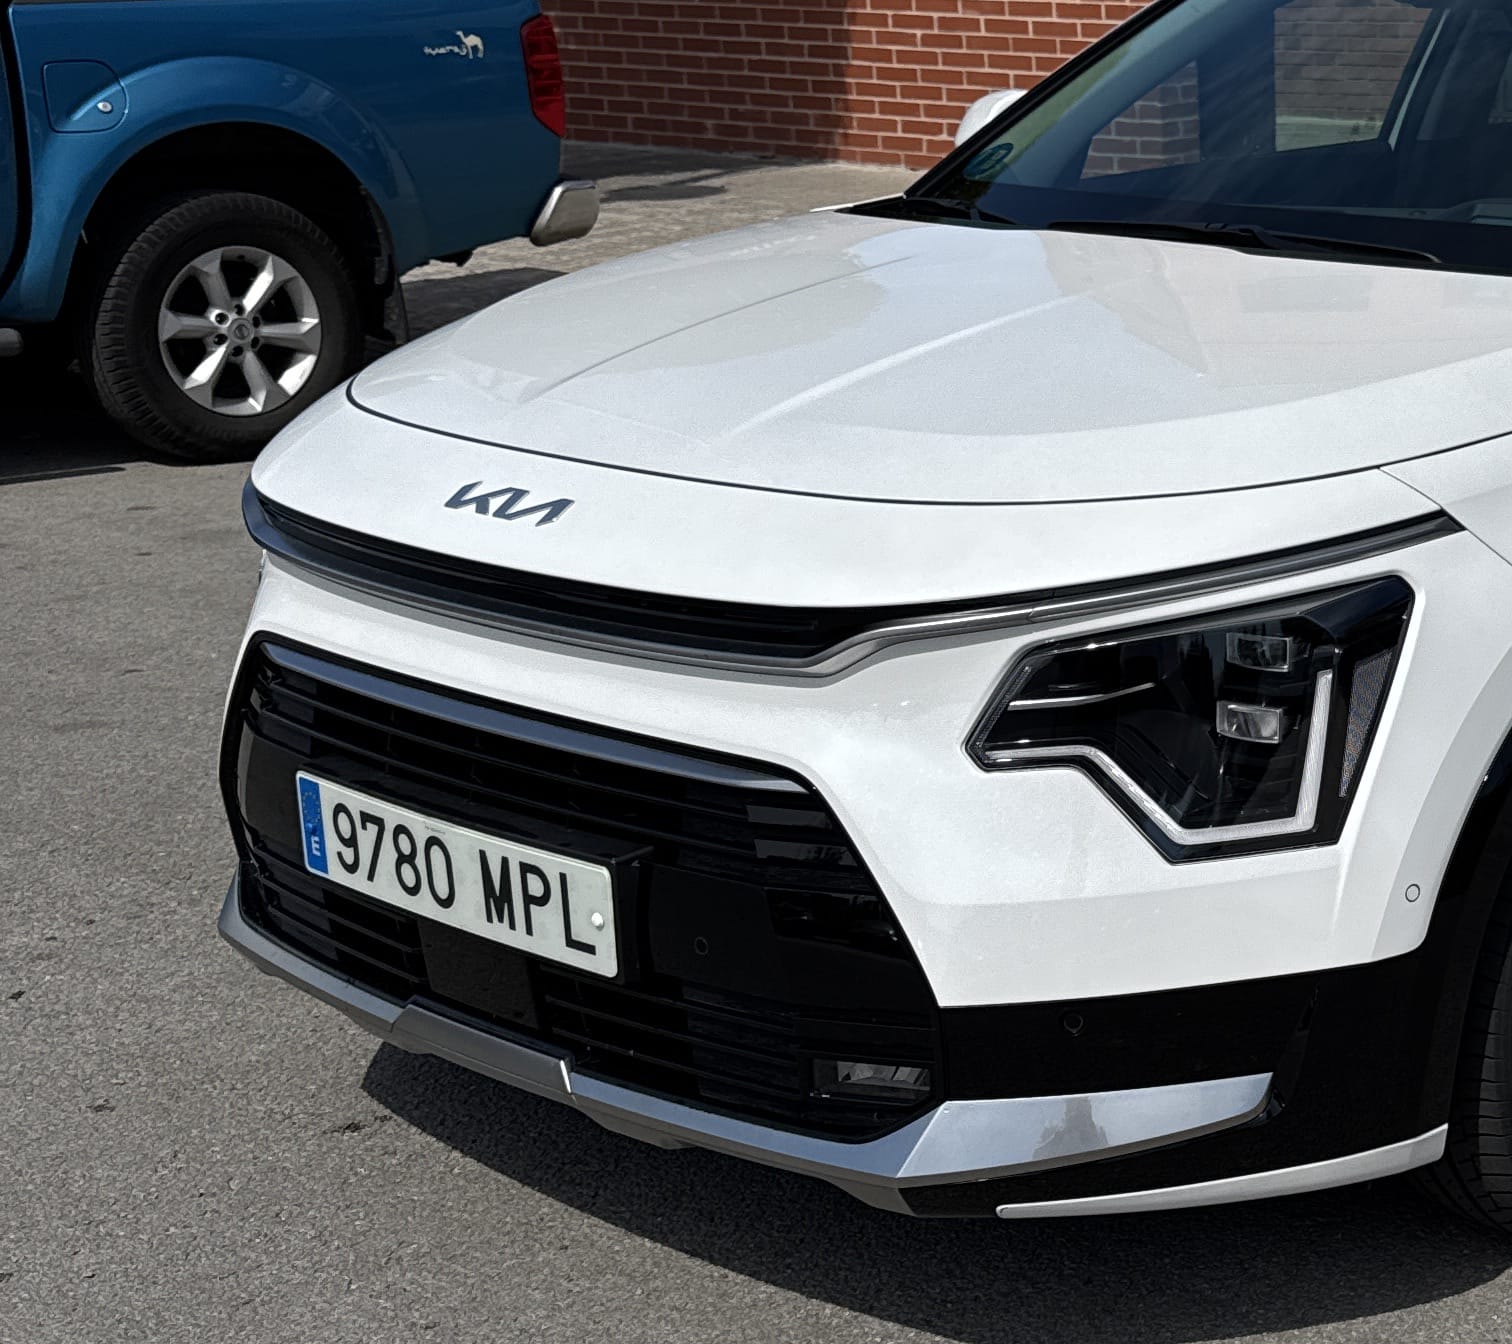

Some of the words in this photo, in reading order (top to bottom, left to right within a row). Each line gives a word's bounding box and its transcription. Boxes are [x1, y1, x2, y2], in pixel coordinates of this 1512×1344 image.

[444, 480, 576, 528] KIA
[311, 835, 321, 857] E
[332, 802, 456, 909] 9780
[478, 848, 597, 957] MPL
